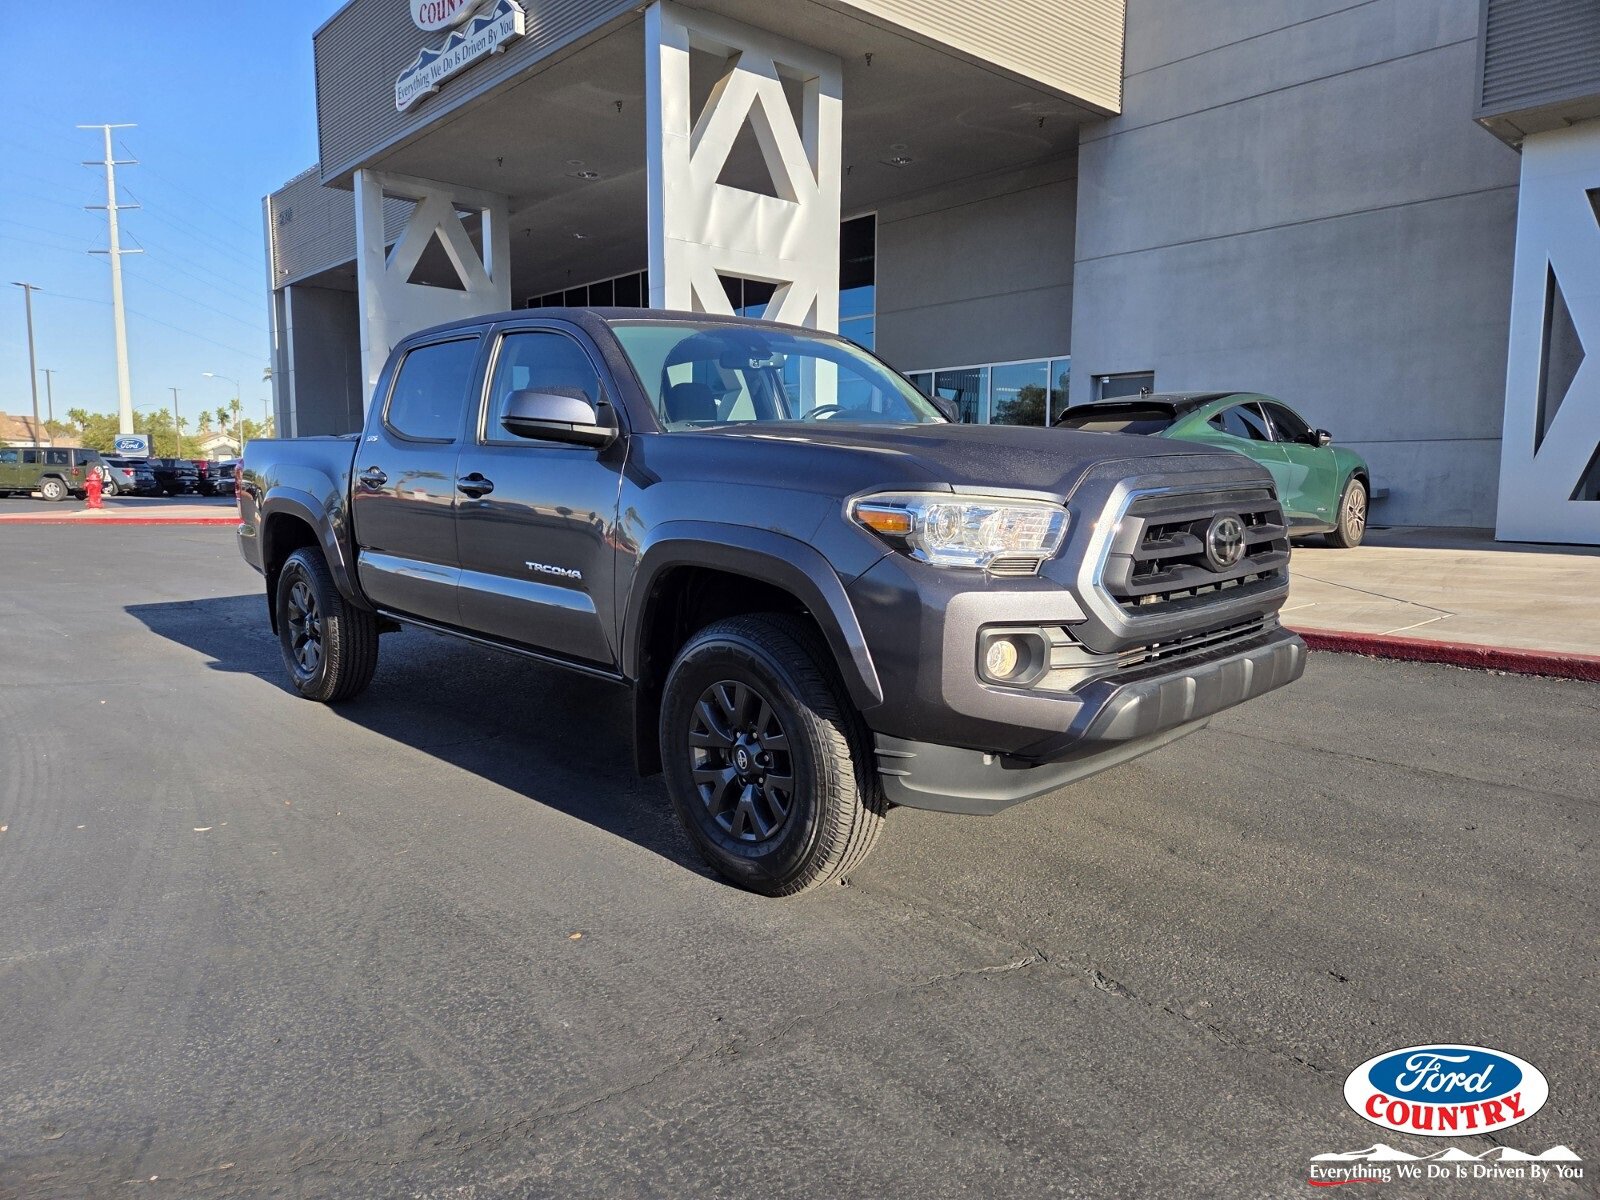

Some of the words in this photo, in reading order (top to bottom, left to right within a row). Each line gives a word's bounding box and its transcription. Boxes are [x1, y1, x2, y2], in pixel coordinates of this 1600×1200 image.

[398, 74, 430, 100] Everything
[430, 65, 442, 80] We
[443, 57, 453, 72] Do
[454, 52, 461, 64] Is
[462, 38, 486, 60] Driven
[488, 29, 498, 48] By
[499, 19, 514, 36] You
[120, 440, 139, 449] Ford
[525, 561, 582, 579] TACOMA
